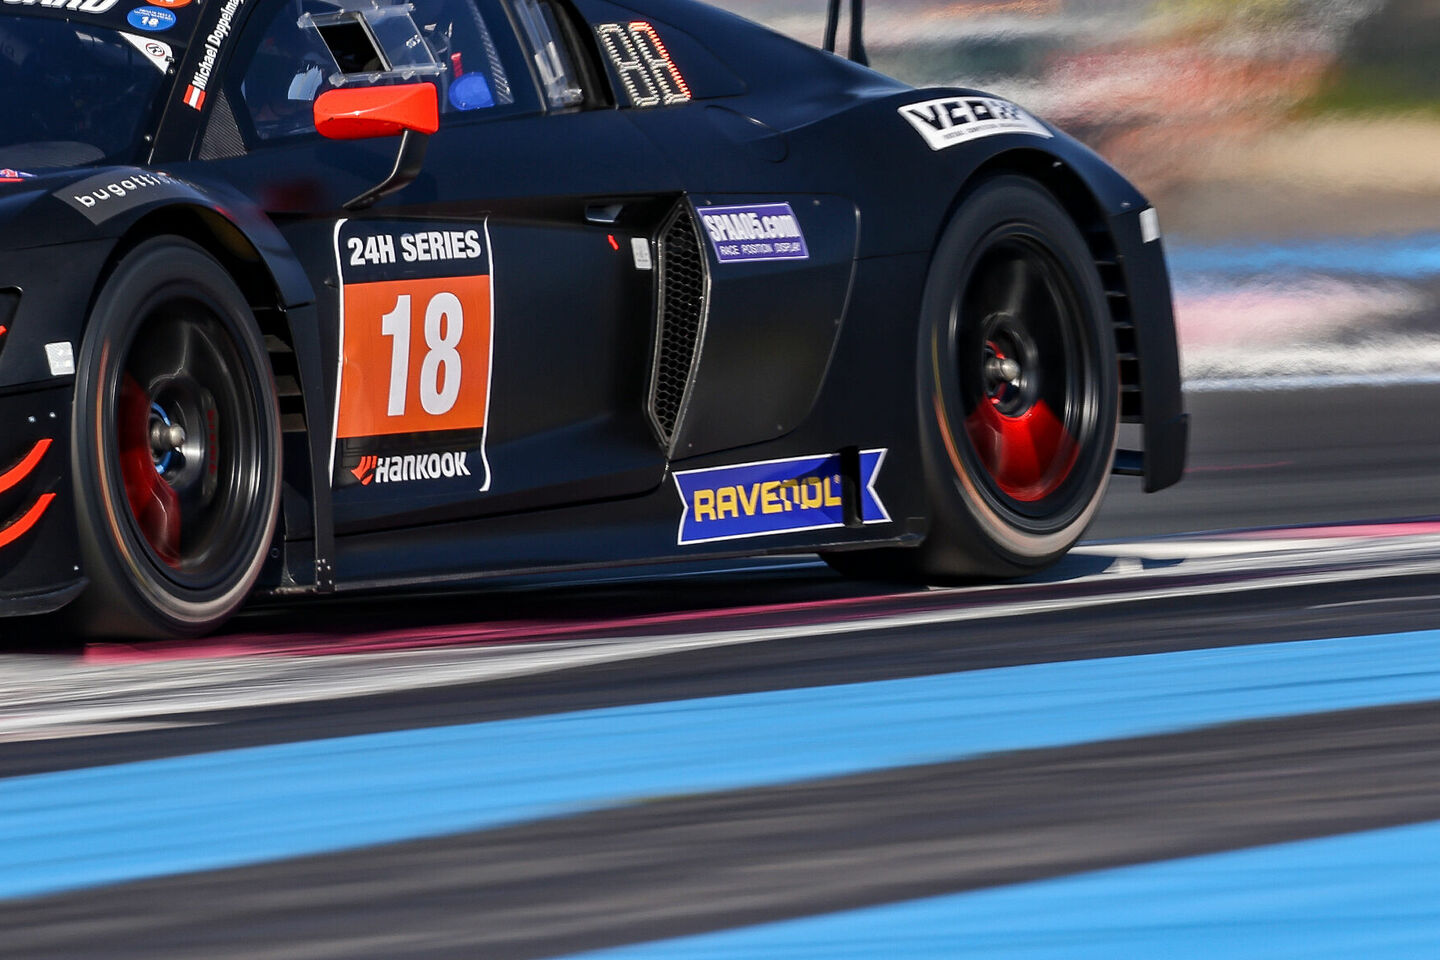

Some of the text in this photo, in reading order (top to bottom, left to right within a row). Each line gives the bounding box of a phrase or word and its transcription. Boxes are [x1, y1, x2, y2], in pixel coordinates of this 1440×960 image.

[192, 43, 218, 90] Michael
[74, 173, 160, 208] bugatti
[347, 229, 482, 266] 24H SERIES
[382, 291, 465, 417] 18
[693, 476, 842, 523] RAVENOL
